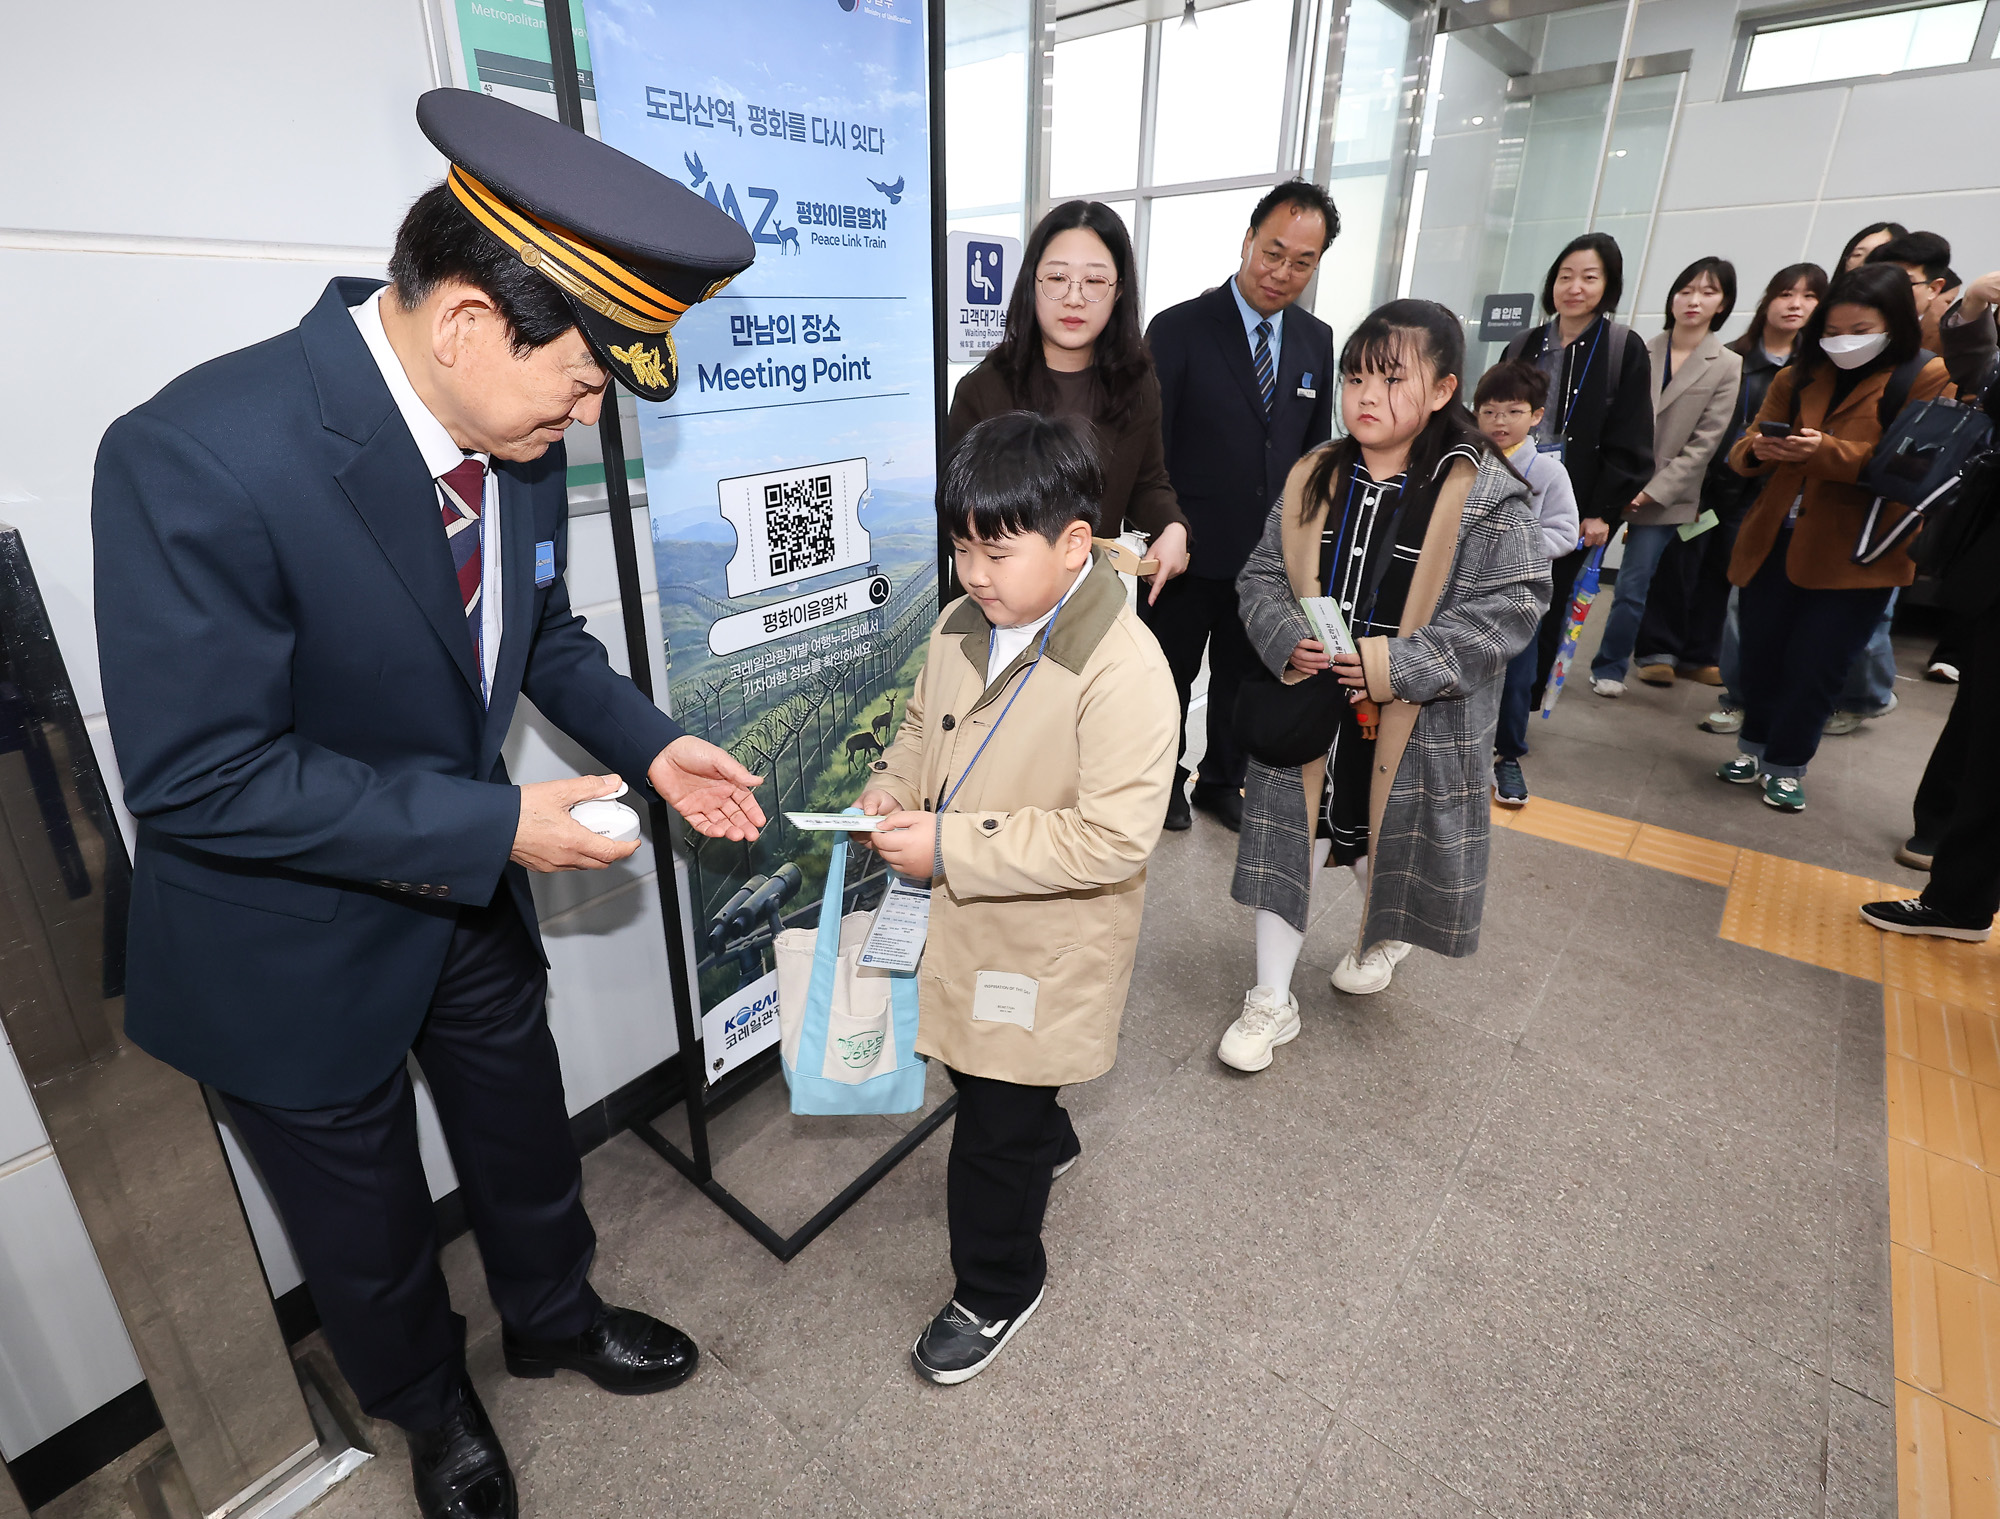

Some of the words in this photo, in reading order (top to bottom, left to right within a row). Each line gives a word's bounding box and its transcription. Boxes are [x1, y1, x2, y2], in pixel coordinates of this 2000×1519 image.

[471, 2, 547, 29] Metropolitan
[645, 86, 743, 138] 도라산역,
[747, 103, 807, 143] 평화를
[811, 116, 846, 149] 다시
[850, 123, 885, 155] 잇다
[796, 201, 888, 231] 평화이음열차
[811, 232, 840, 247] Peace
[842, 233, 862, 248] Link
[863, 235, 887, 249] Train
[1491, 307, 1523, 320] 출입문
[730, 314, 797, 347] 만남의
[801, 314, 842, 344] 장소
[964, 328, 987, 339] Waiting
[987, 329, 1004, 337] Room
[698, 357, 807, 393] Meeting
[812, 353, 872, 384] Point
[763, 592, 848, 633] 평화이음열차
[730, 641, 809, 680] 코레일관광개발
[811, 619, 880, 652] 여행누리집에서
[742, 671, 788, 698] 기차여행
[789, 659, 822, 680] 정보를
[823, 641, 873, 668] 확인하세요
